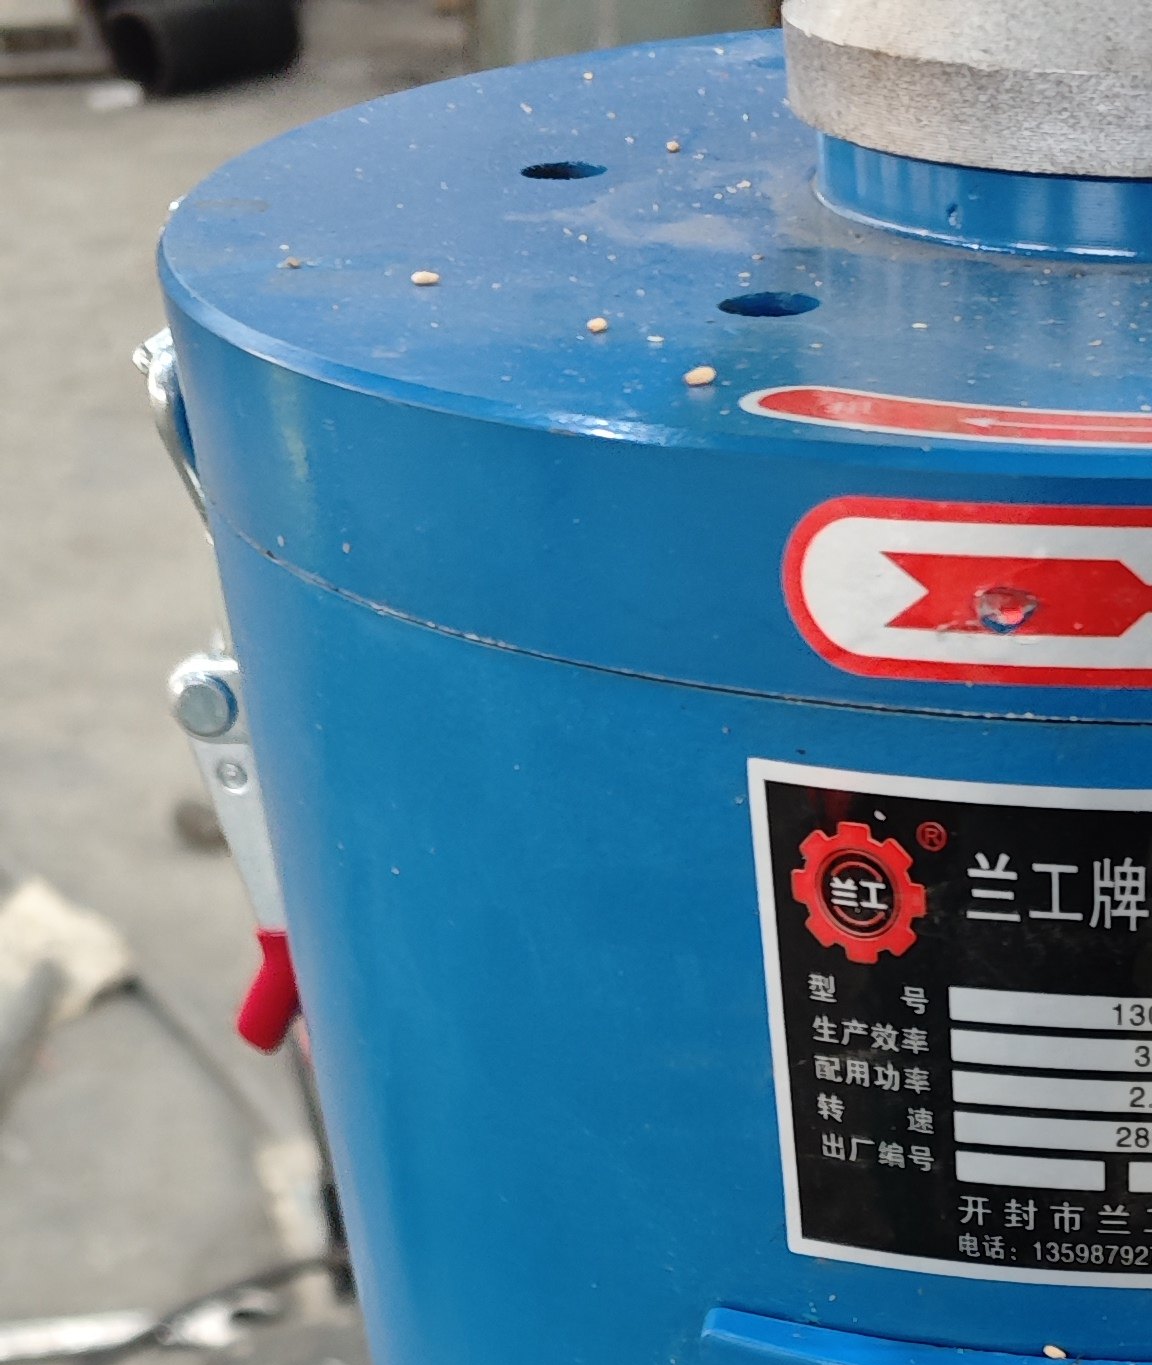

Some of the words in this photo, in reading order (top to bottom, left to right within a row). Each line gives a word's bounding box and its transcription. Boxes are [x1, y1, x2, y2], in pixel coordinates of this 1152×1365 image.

[829, 876, 889, 910] 兰工
[812, 1014, 930, 1054] 生产效率
[813, 1055, 932, 1094] 配用功率
[821, 1132, 935, 1171] 出厂编号
